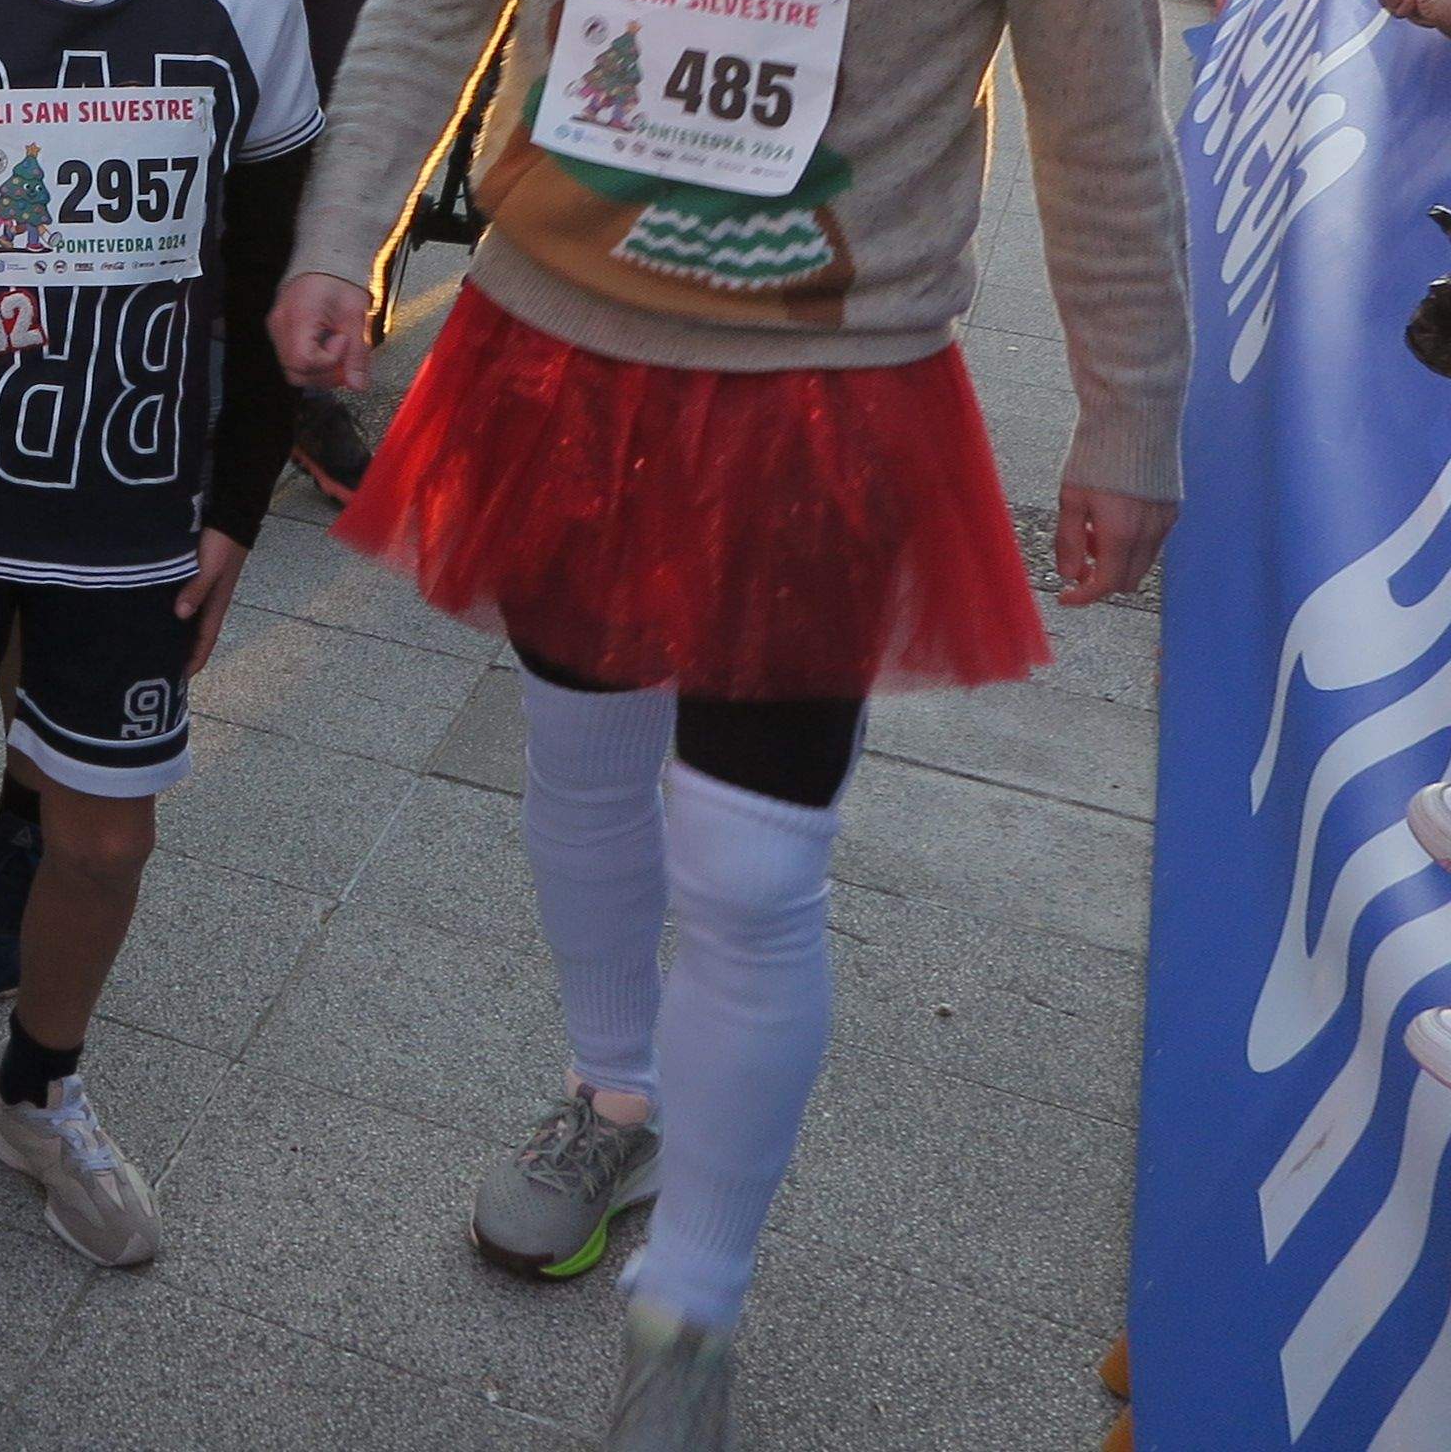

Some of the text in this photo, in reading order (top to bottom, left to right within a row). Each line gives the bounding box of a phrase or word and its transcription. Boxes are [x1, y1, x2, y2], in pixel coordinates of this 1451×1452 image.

[21, 101, 69, 124] SAN
[78, 99, 194, 123] SILVESTRE
[662, 48, 798, 128] 485
[56, 156, 200, 225] 2957
[55, 234, 187, 254] PONTEVEDRA 2024
